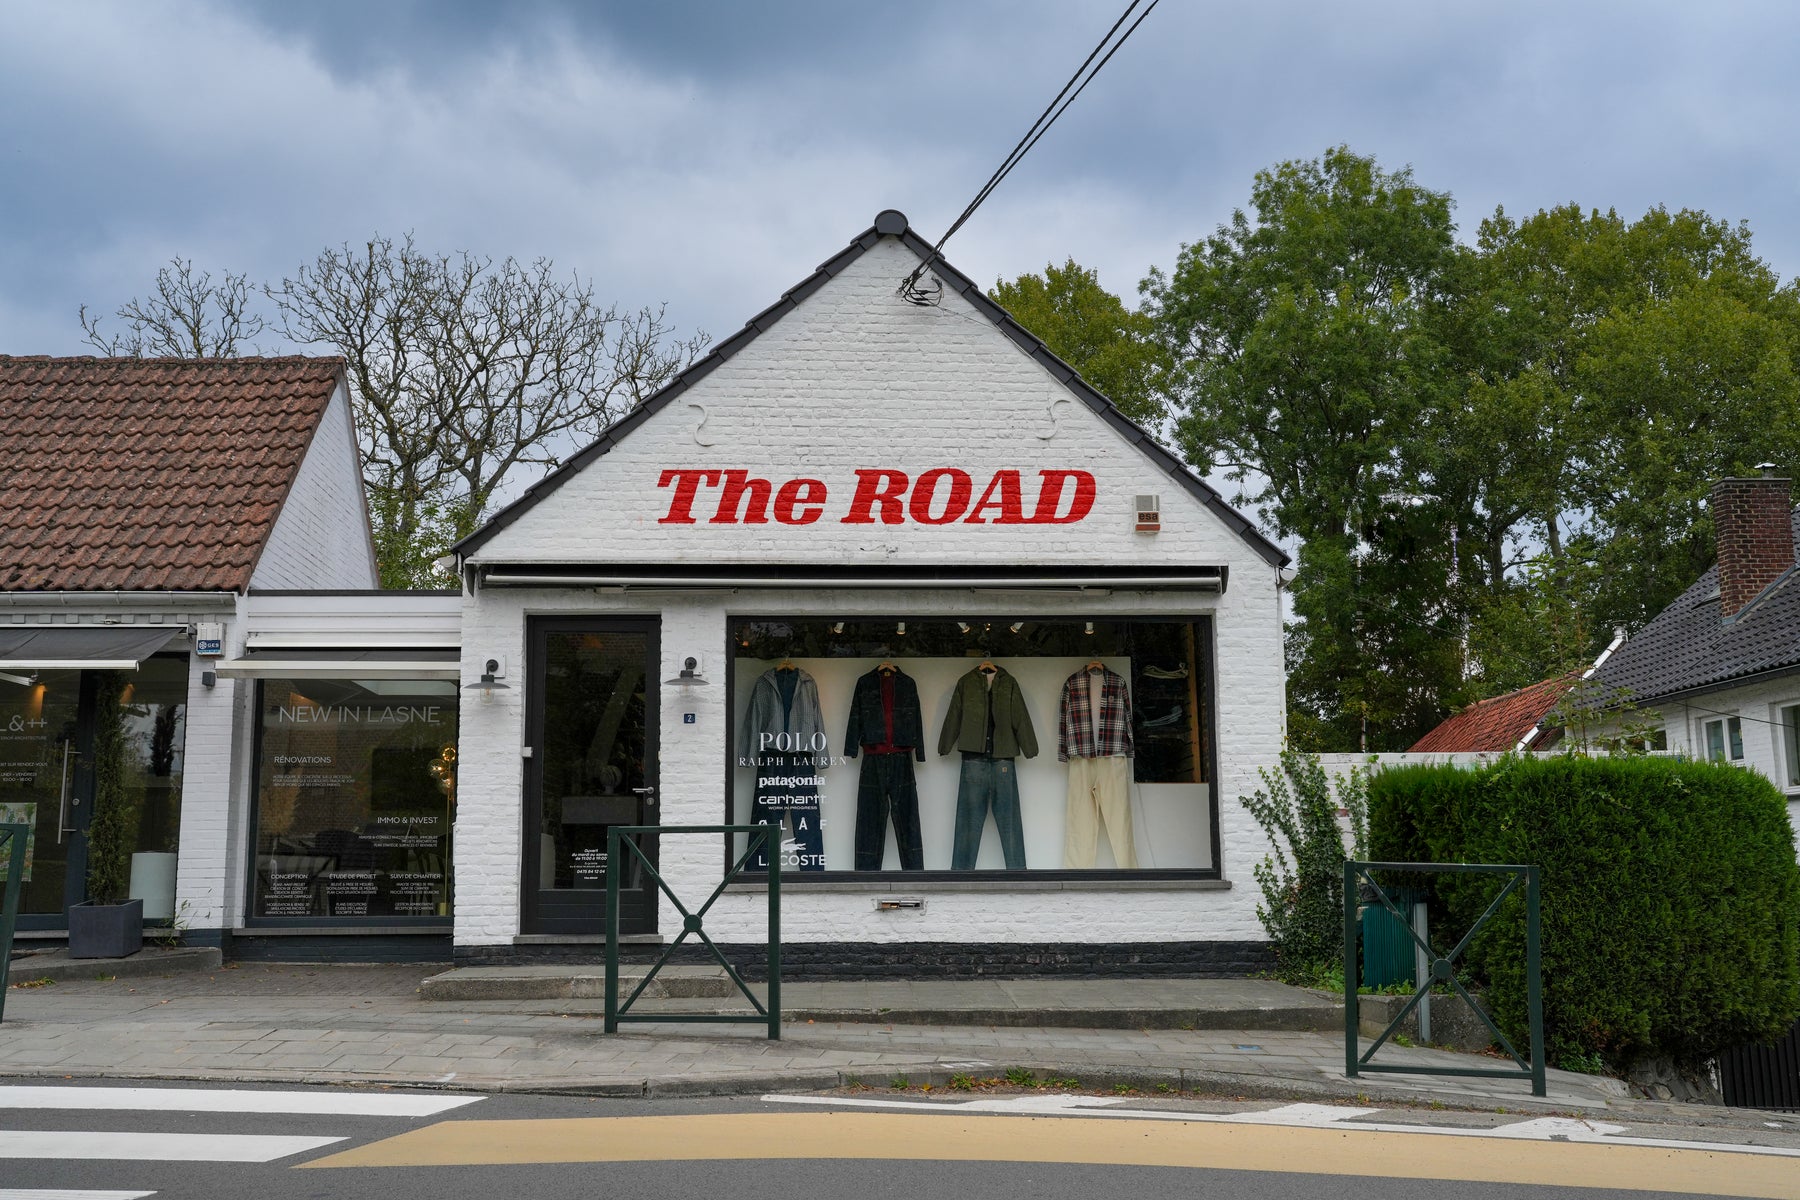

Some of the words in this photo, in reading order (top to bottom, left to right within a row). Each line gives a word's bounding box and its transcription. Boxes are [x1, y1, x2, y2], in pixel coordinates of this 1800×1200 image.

[657, 469, 827, 525] The
[841, 468, 1096, 525] ROAD
[1139, 512, 1158, 521] esa
[279, 706, 332, 723] NEW
[338, 706, 360, 723] IN
[367, 706, 441, 723] LASNE
[759, 732, 827, 752] POLO
[274, 755, 332, 764] RÉNOVATIONS
[739, 757, 784, 766] RALPH
[793, 757, 848, 766] LAUREN
[758, 774, 826, 788] patagonia
[758, 794, 827, 804] carhartt
[758, 855, 827, 866] LCOSTE
